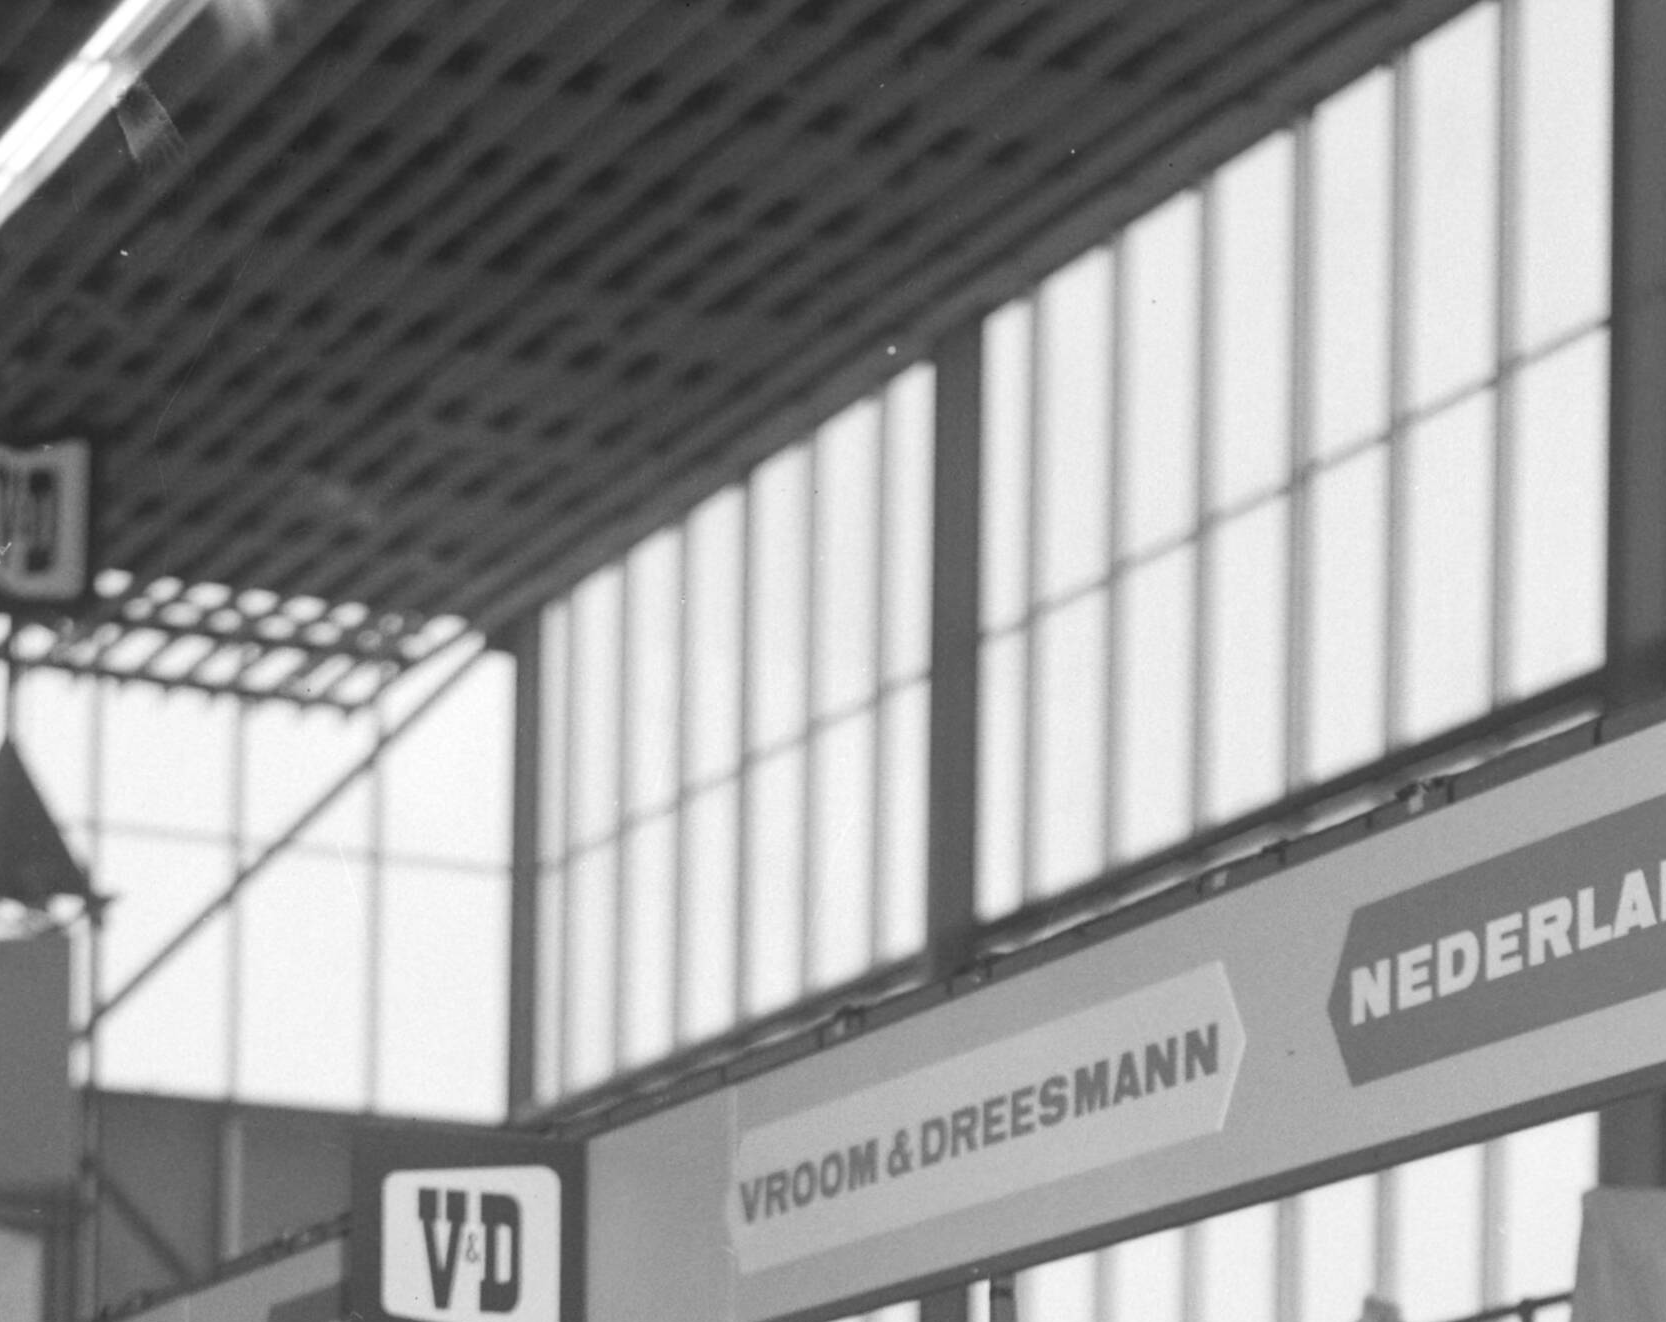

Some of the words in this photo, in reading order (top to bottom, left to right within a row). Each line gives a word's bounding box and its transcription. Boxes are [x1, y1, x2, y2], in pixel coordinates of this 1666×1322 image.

[738, 1136, 879, 1226] VROOM
[887, 1127, 913, 1179] &
[919, 1021, 1220, 1169] DREESMANN
